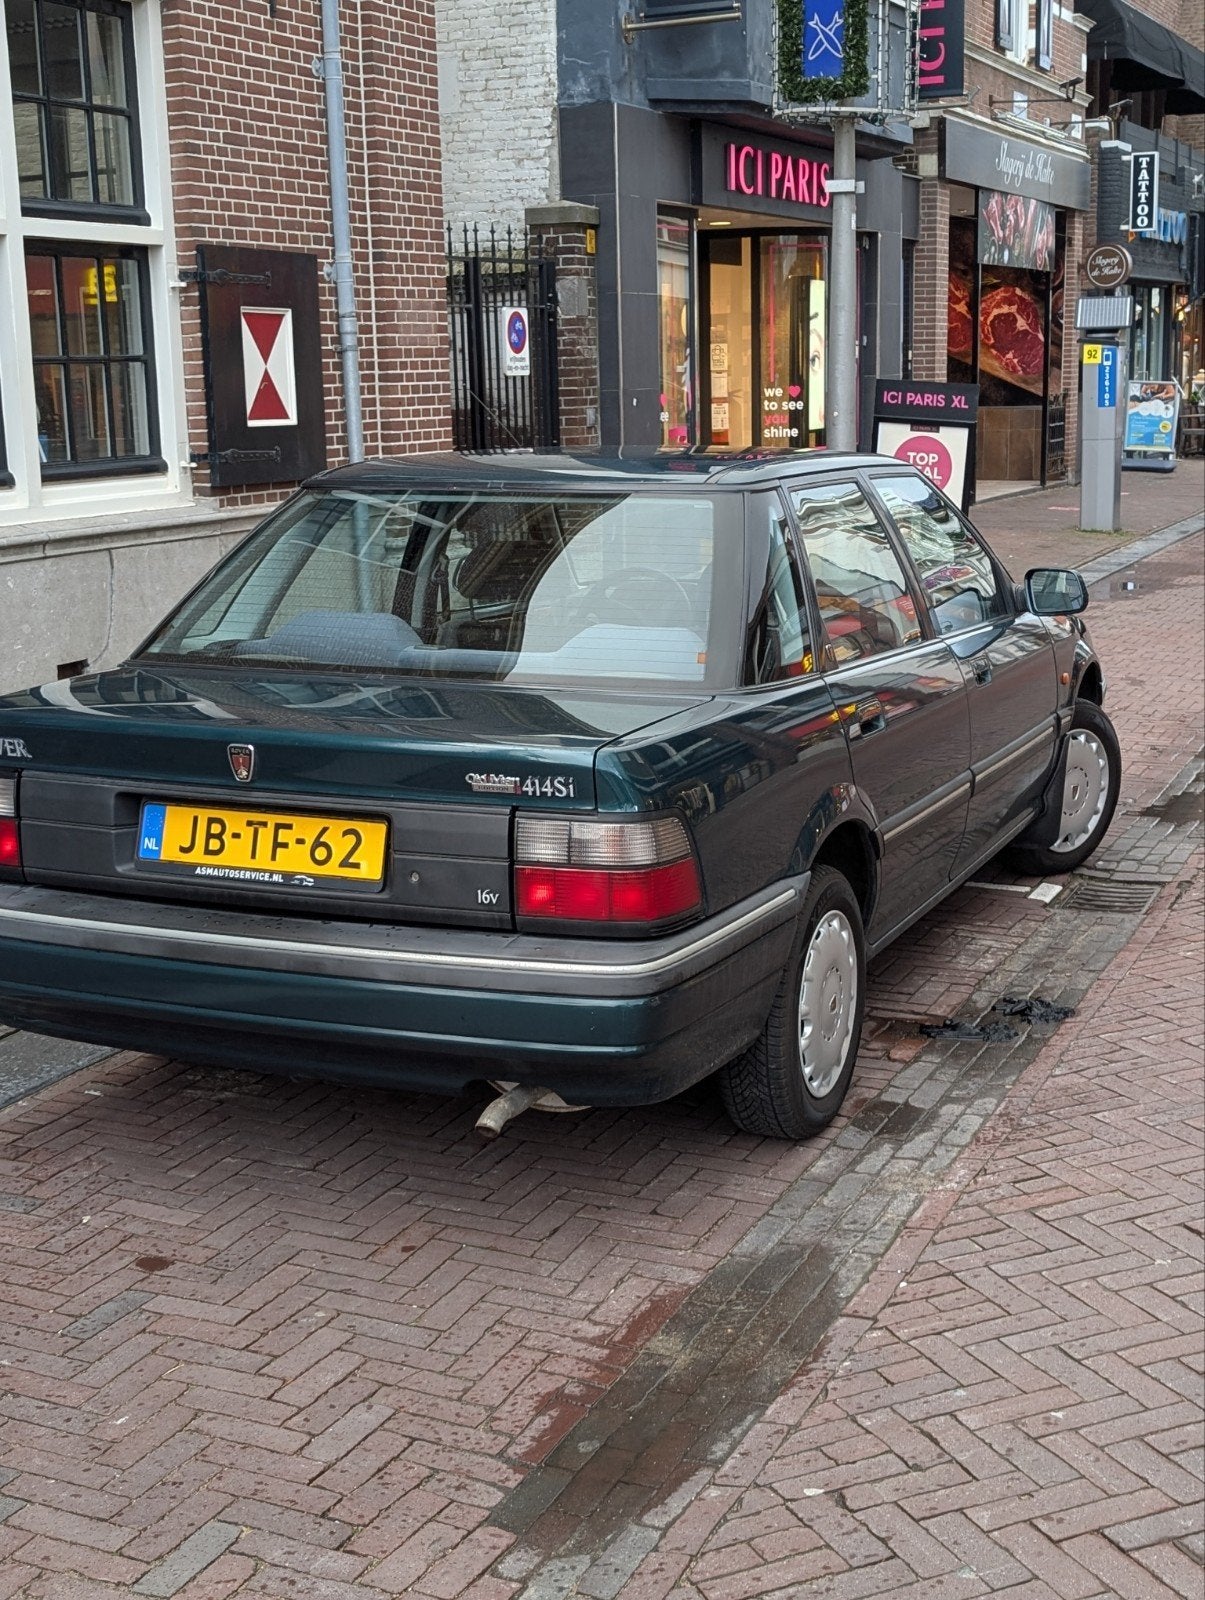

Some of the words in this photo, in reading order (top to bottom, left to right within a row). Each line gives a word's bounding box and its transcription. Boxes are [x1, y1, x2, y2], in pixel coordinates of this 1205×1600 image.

[1025, 150, 1034, 179] de
[728, 143, 763, 196] ICI
[770, 152, 830, 207] PARIS
[1136, 157, 1150, 228] TATTOO
[1087, 350, 1098, 359] 92
[764, 387, 783, 397] we
[883, 390, 902, 404] ICI
[906, 392, 946, 407] PARIS
[951, 395, 969, 408] XL
[764, 399, 778, 410] to
[782, 401, 804, 410] see
[764, 414, 789, 426] you
[763, 425, 799, 438] shine
[907, 451, 939, 466] TOP
[917, 466, 942, 480] AL
[522, 776, 574, 797] 414Si
[144, 837, 159, 850] NL
[179, 815, 362, 870] JB-TF-62
[195, 866, 284, 883] ASMAUTOSERVICE.NL
[477, 889, 500, 904] 16v
